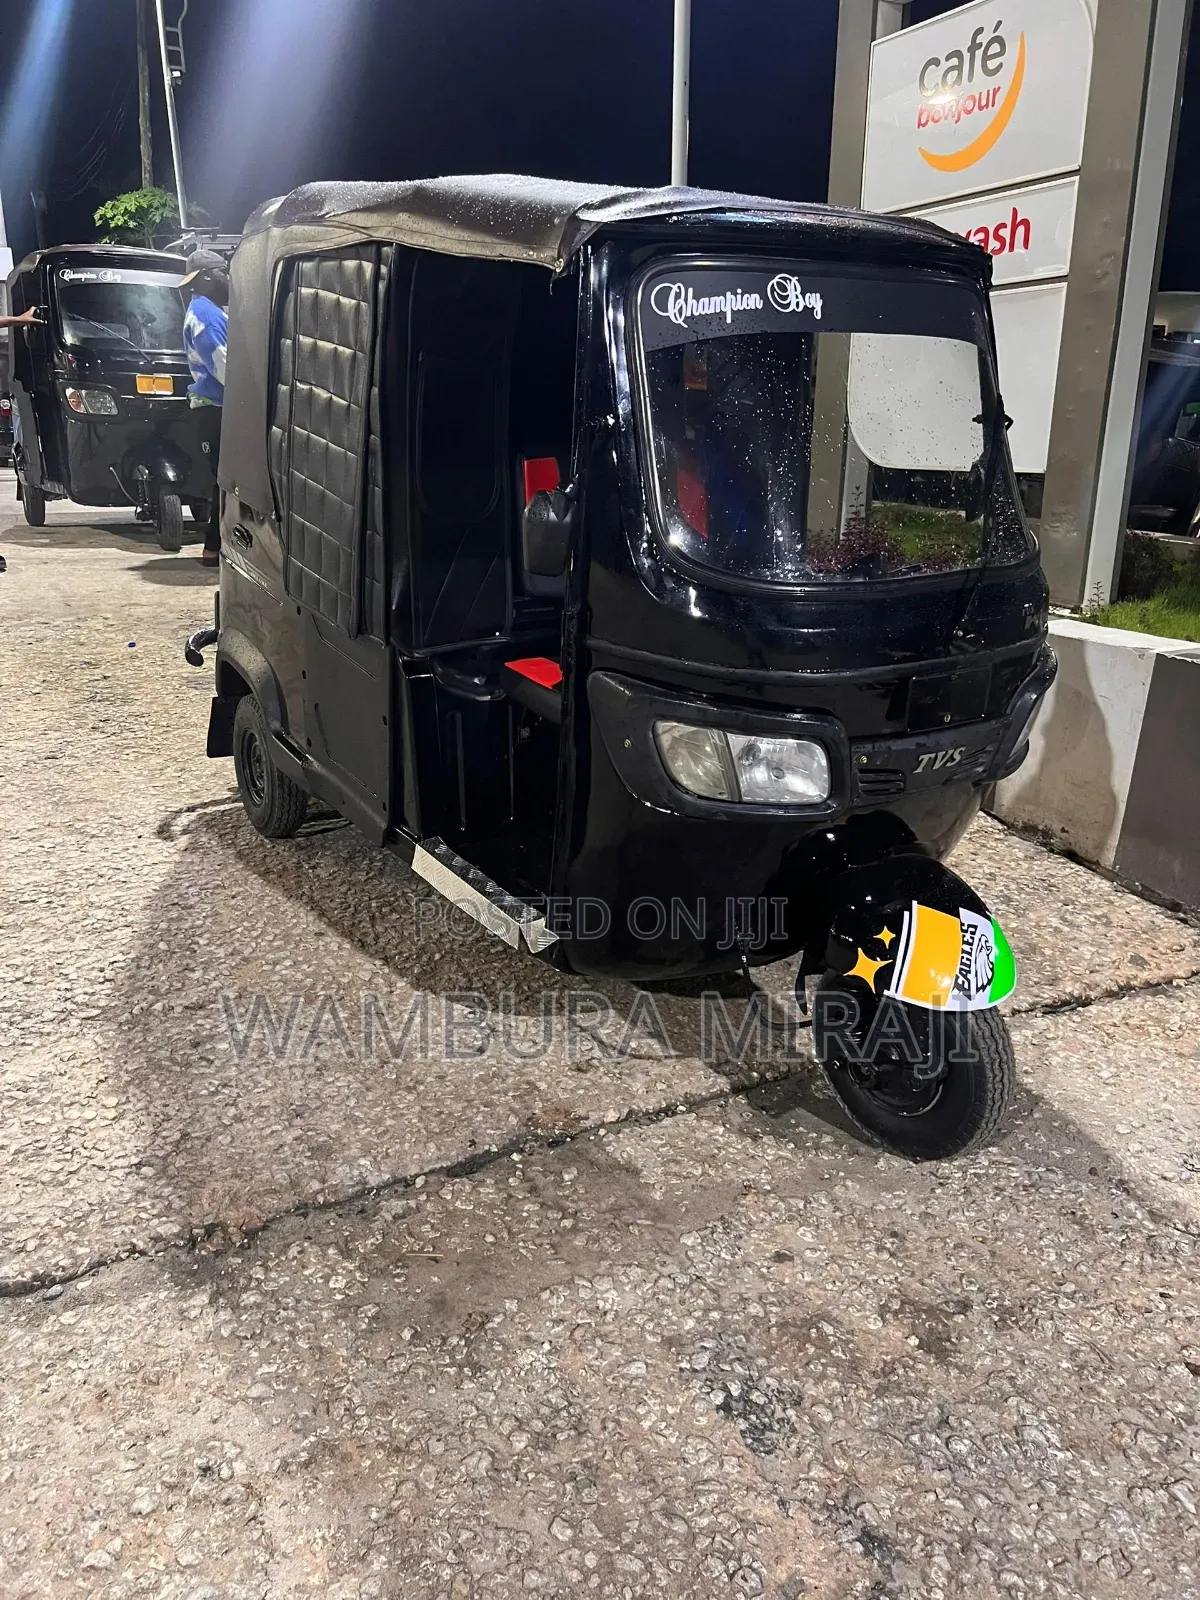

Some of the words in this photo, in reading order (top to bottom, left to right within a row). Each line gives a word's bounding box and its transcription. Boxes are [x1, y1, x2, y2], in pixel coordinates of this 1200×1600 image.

[918, 20, 1007, 97] café
[916, 86, 1001, 129] bonjour
[965, 206, 1031, 256] ash
[650, 282, 763, 328] Champion
[767, 273, 823, 320] Boy
[912, 746, 967, 774] TVS
[951, 921, 979, 1002] EAGLES
